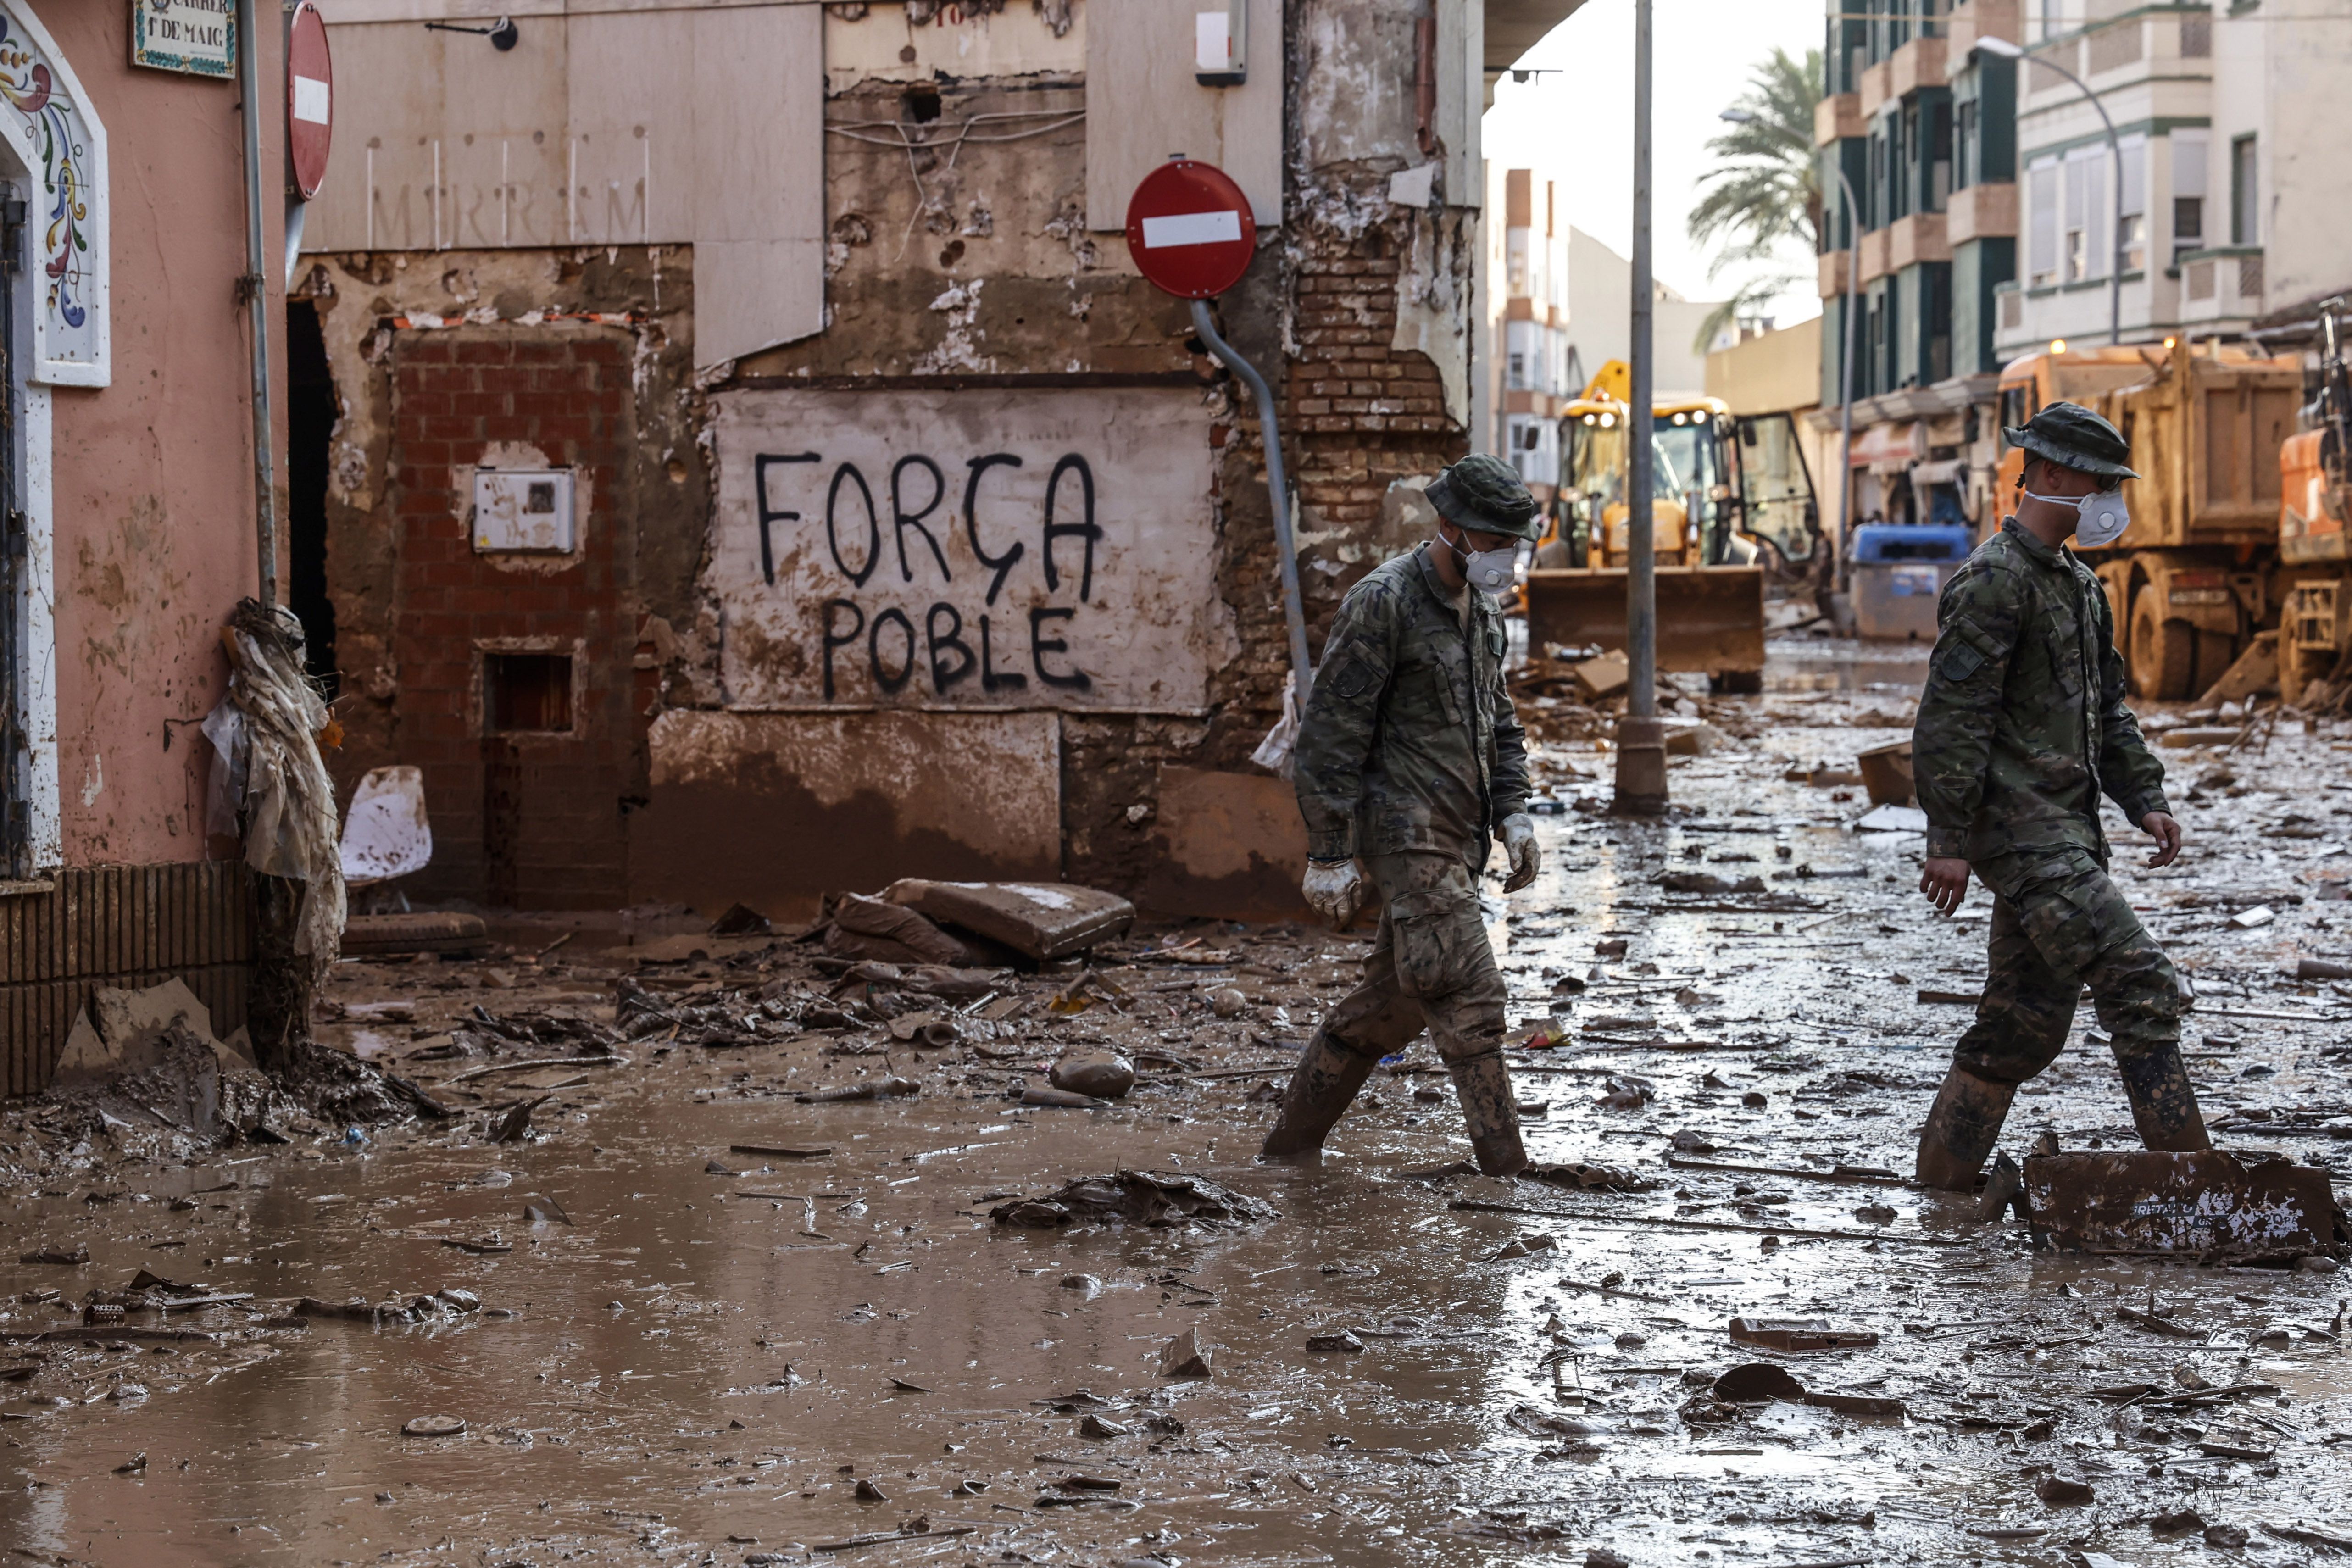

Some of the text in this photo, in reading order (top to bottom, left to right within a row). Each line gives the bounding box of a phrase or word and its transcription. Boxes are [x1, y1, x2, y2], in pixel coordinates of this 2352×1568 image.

[162, 19, 180, 40] DE
[184, 23, 223, 47] MAIG
[755, 452, 1103, 606] FORÇA
[823, 598, 1091, 701] POBLE
